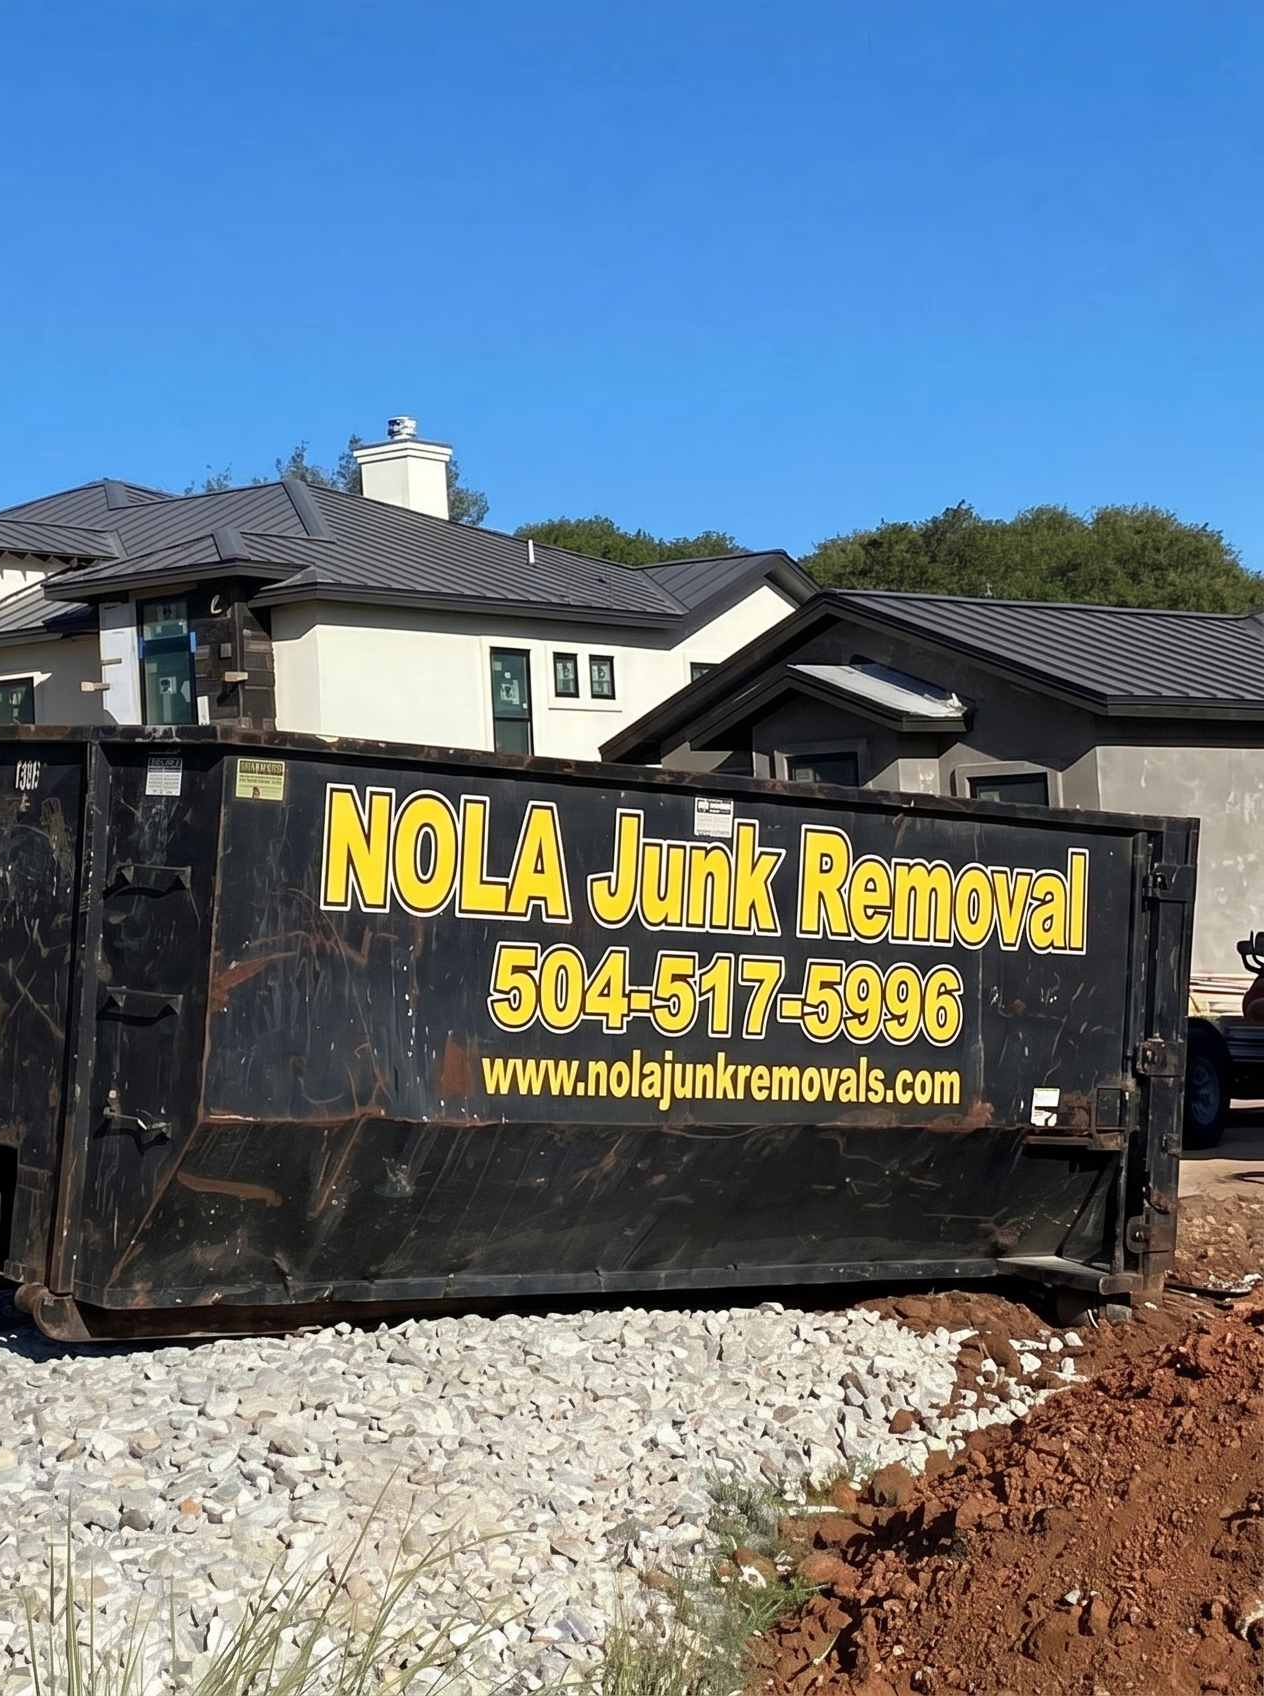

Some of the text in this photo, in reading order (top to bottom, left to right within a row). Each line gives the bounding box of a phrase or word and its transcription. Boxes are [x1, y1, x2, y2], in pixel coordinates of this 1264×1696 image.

[321, 784, 1090, 955] NOLA Junk Removal
[488, 942, 964, 1045] 504-517-5996
[482, 1051, 961, 1110] www.nolajunkremovals.com
